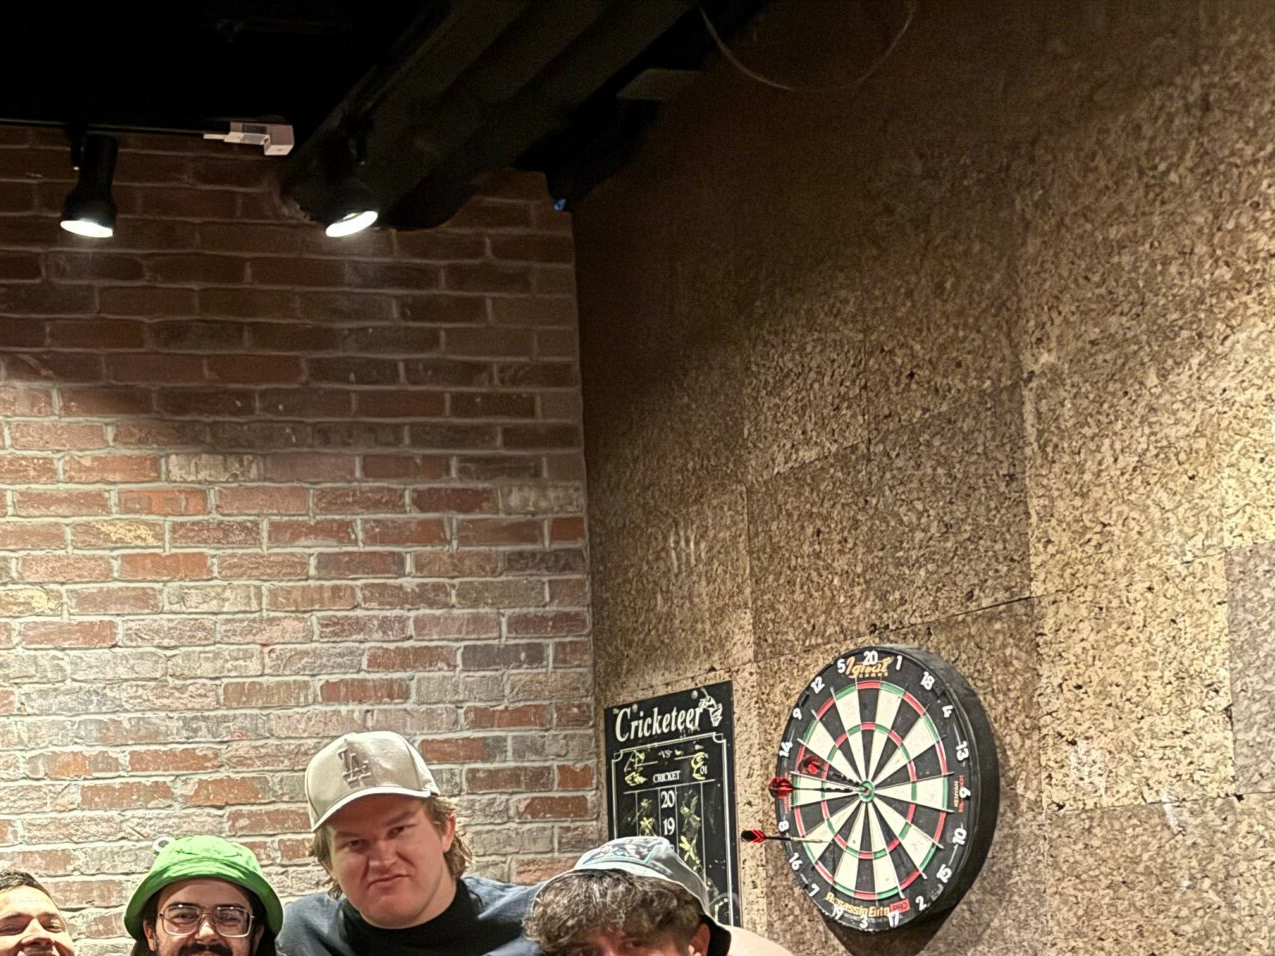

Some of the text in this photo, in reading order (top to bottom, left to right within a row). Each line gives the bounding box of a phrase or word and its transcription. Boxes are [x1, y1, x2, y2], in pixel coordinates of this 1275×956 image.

[863, 650, 878, 665] 20
[894, 655, 904, 670] 1
[837, 659, 846, 673] 5
[811, 676, 825, 694] 12
[921, 672, 935, 690] 18
[792, 708, 802, 720] 9
[942, 705, 954, 718] 4
[615, 704, 702, 742] Cricketeer
[779, 741, 792, 758] 14
[955, 741, 969, 761] 13
[652, 771, 681, 784] CRICKET
[661, 790, 675, 808] 20
[663, 818, 675, 835] 19
[952, 828, 967, 846] 10
[789, 852, 802, 871] 16
[937, 867, 952, 882] 15
[915, 896, 927, 911] 2
[831, 905, 844, 921] 19
[859, 915, 869, 928] 3
